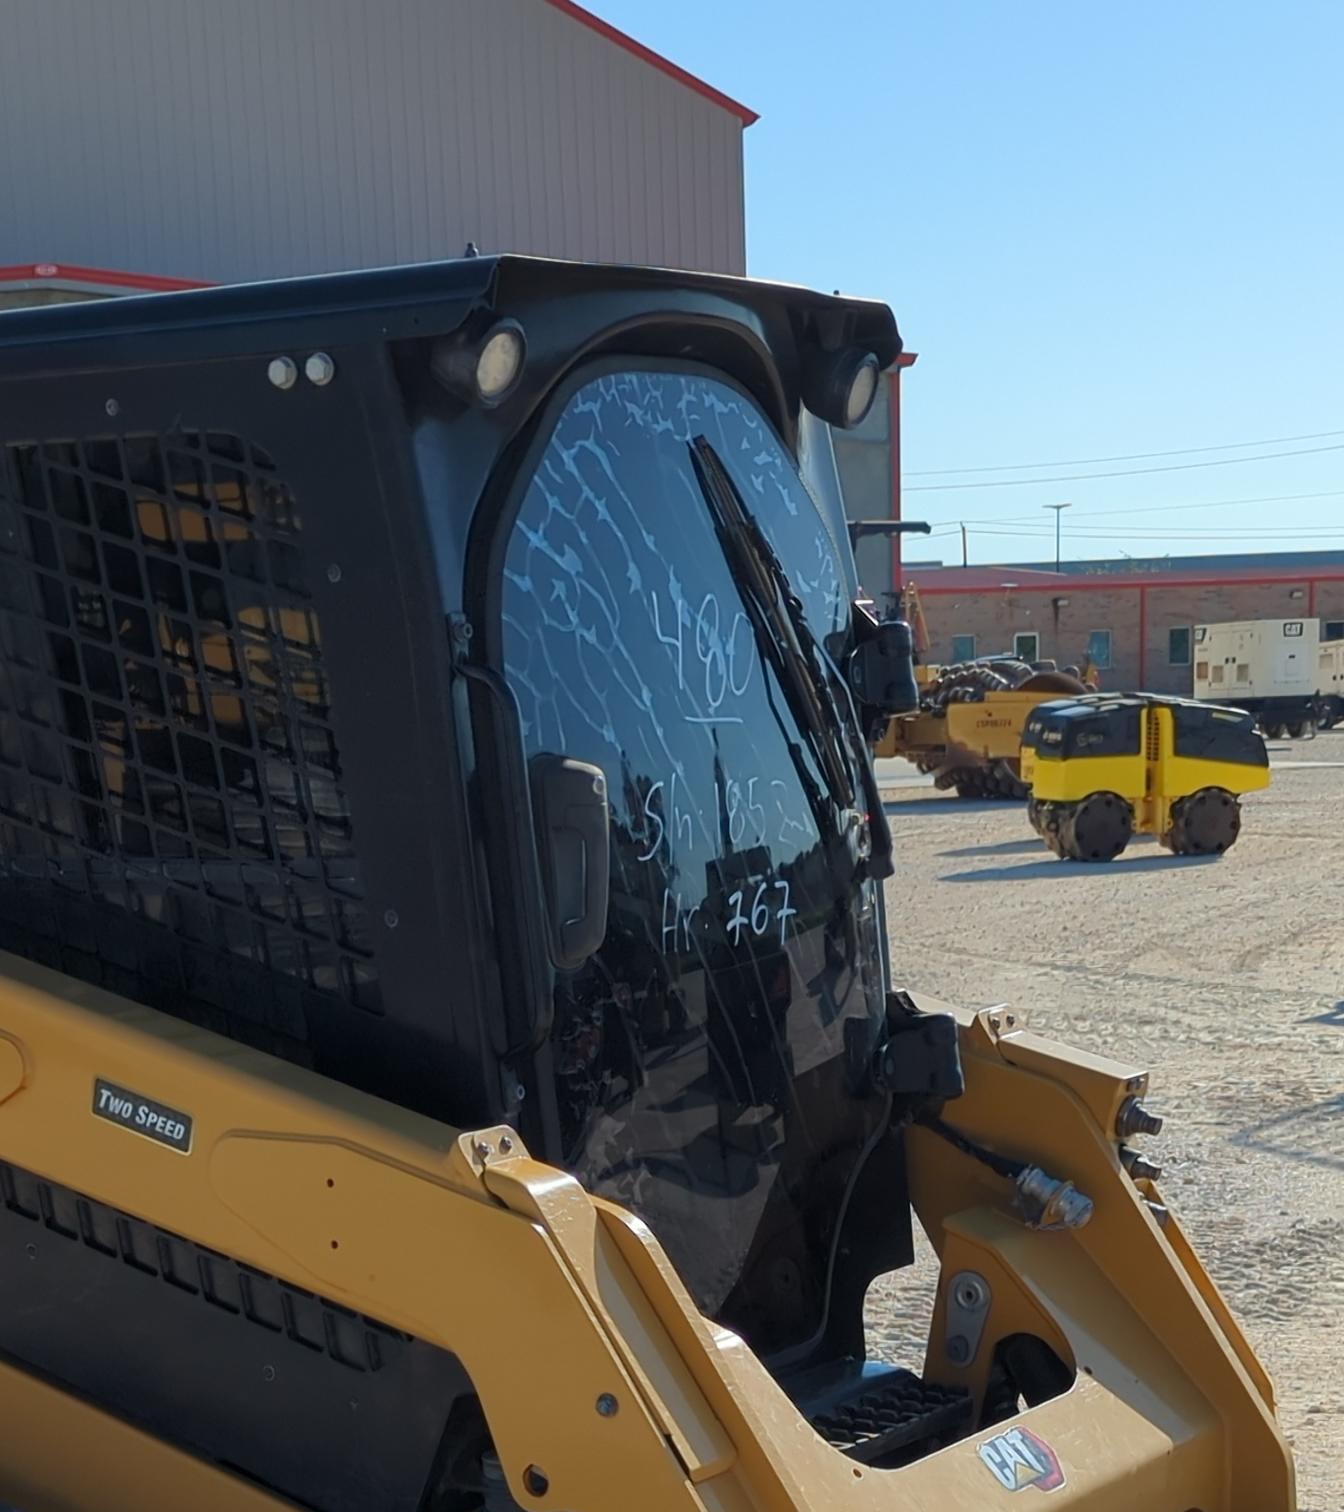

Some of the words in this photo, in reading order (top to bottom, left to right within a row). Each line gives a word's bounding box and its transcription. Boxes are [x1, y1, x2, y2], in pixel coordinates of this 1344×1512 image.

[651, 592, 756, 707] 480
[726, 881, 797, 947] 767
[979, 1429, 1047, 1490] CAT
